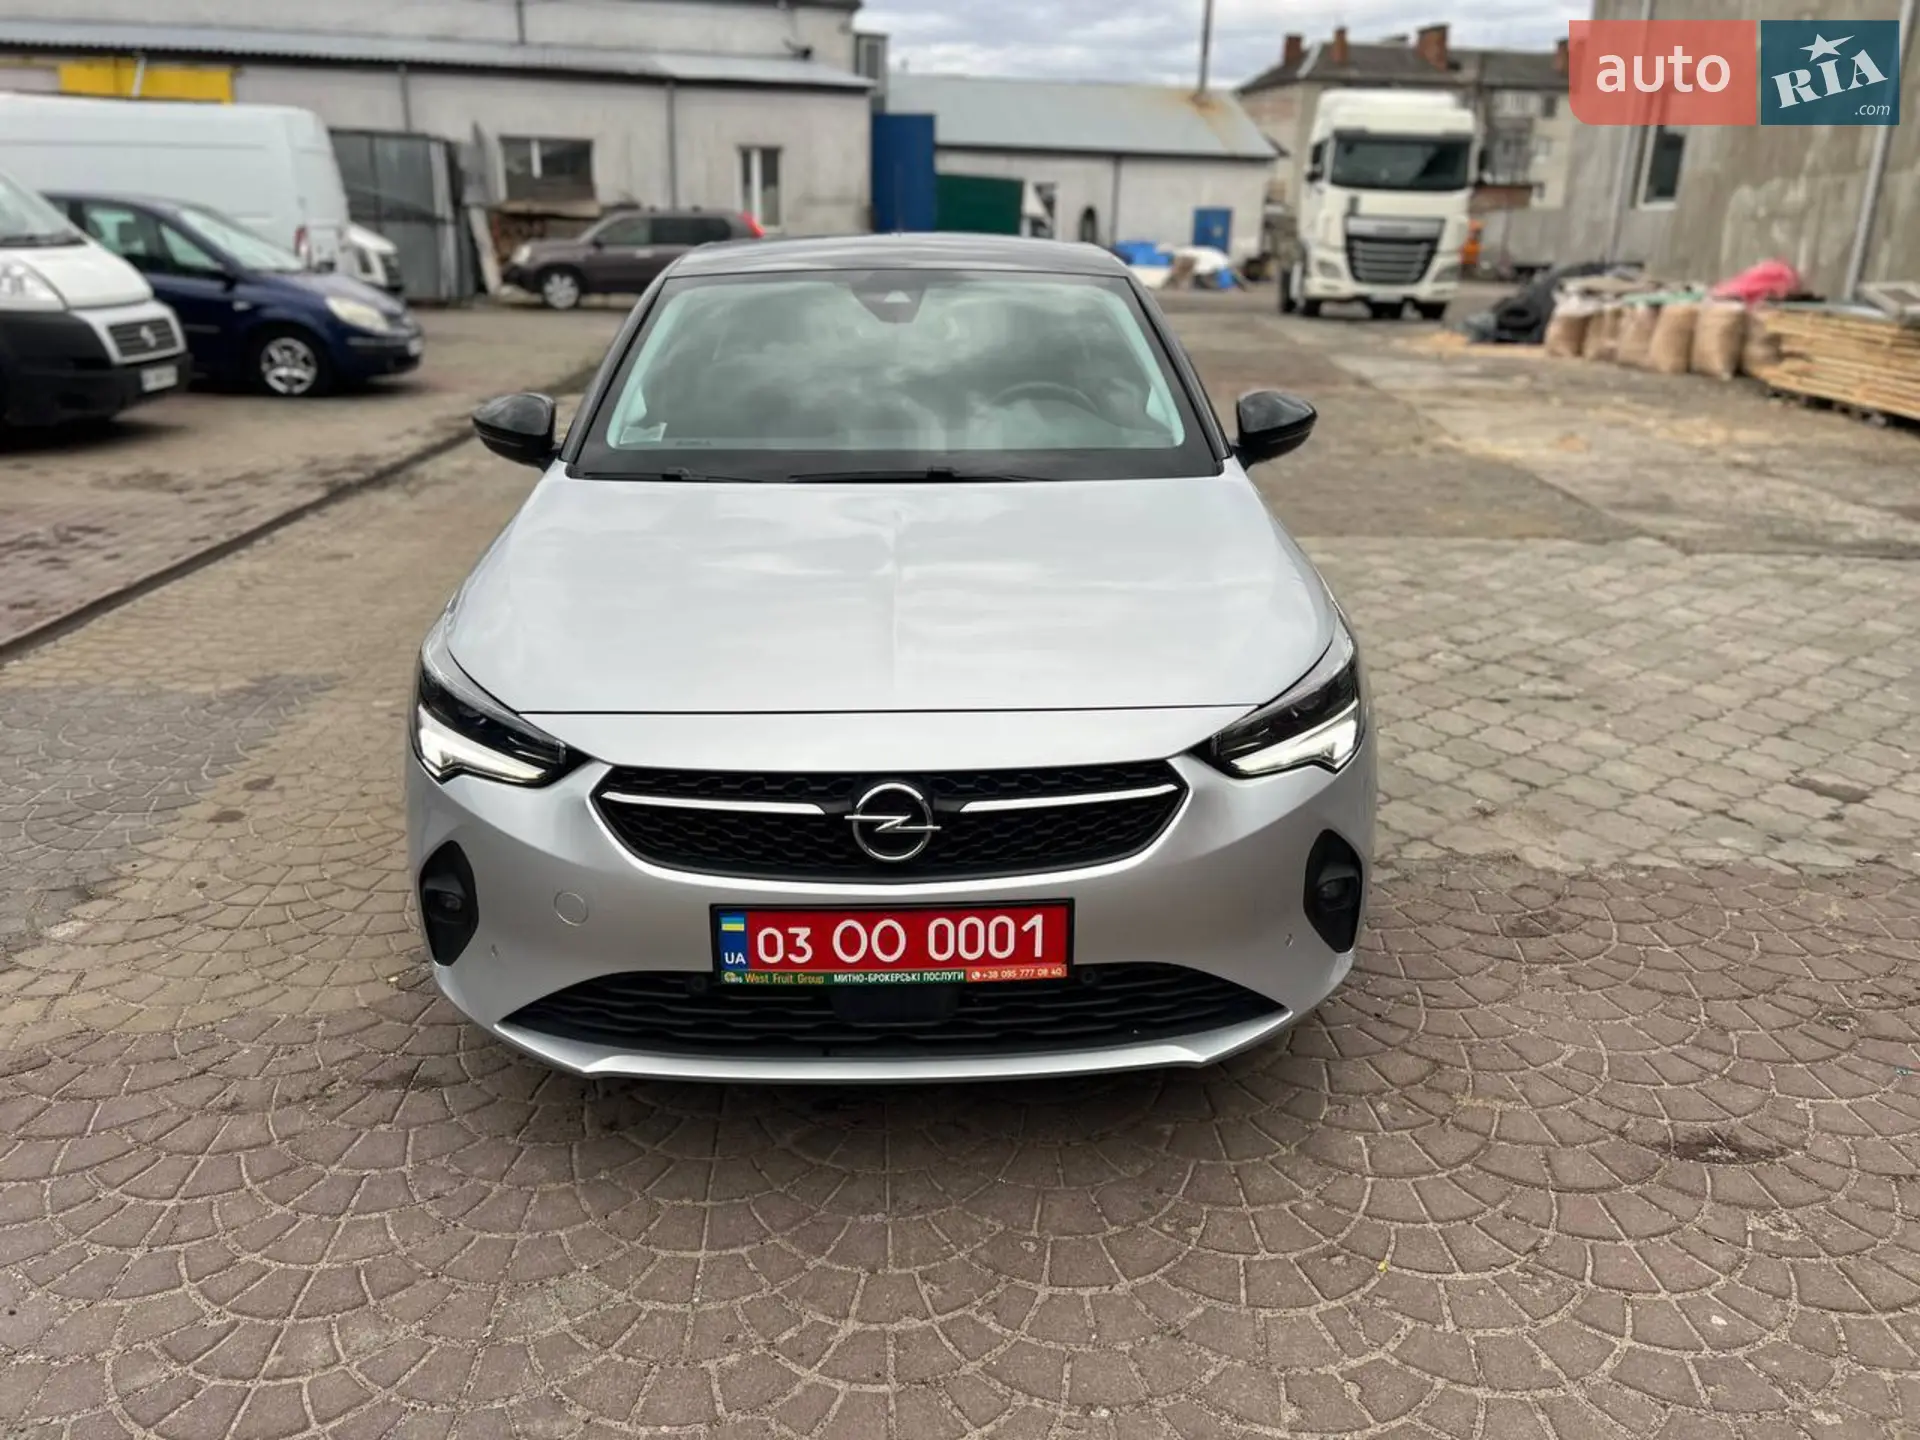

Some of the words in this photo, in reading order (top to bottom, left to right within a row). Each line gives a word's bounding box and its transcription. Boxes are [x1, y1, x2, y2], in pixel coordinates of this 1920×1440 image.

[757, 926, 813, 964] 03
[832, 918, 907, 964] OO
[927, 914, 1044, 960] 0001
[724, 951, 747, 966] UA
[745, 973, 769, 984] West
[773, 973, 793, 984] Fruit
[798, 974, 825, 984] Group
[834, 972, 920, 983] МИТНО-БРОКЕРСЬКІ
[923, 970, 965, 982] ПОСЛУГИ
